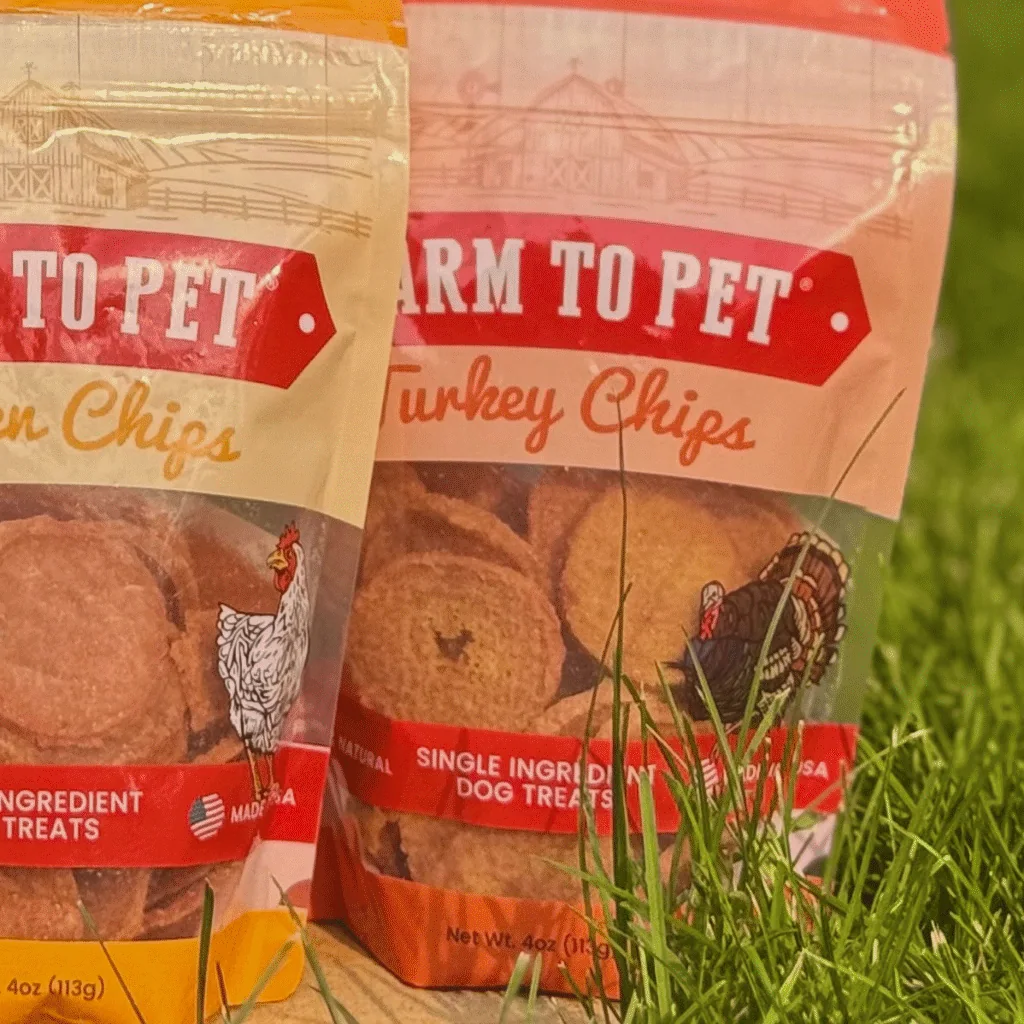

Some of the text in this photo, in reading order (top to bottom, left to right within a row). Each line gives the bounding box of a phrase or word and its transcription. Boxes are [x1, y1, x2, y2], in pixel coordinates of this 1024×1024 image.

[12, 250, 98, 331] TO
[120, 256, 258, 349] PET
[396, 237, 795, 346] ARM TO PET
[62, 377, 242, 481] Chips
[580, 365, 756, 467] Chips
[415, 746, 657, 787] SINGLE INGRDINT
[796, 759, 830, 780] SA
[456, 776, 514, 803] DOG
[1, 816, 100, 841] TREATS
[446, 926, 479, 946] Net
[484, 931, 516, 950] Wt.
[520, 935, 557, 953] 4oz
[6, 977, 42, 997] 4oz
[48, 974, 105, 1002] (113g)
